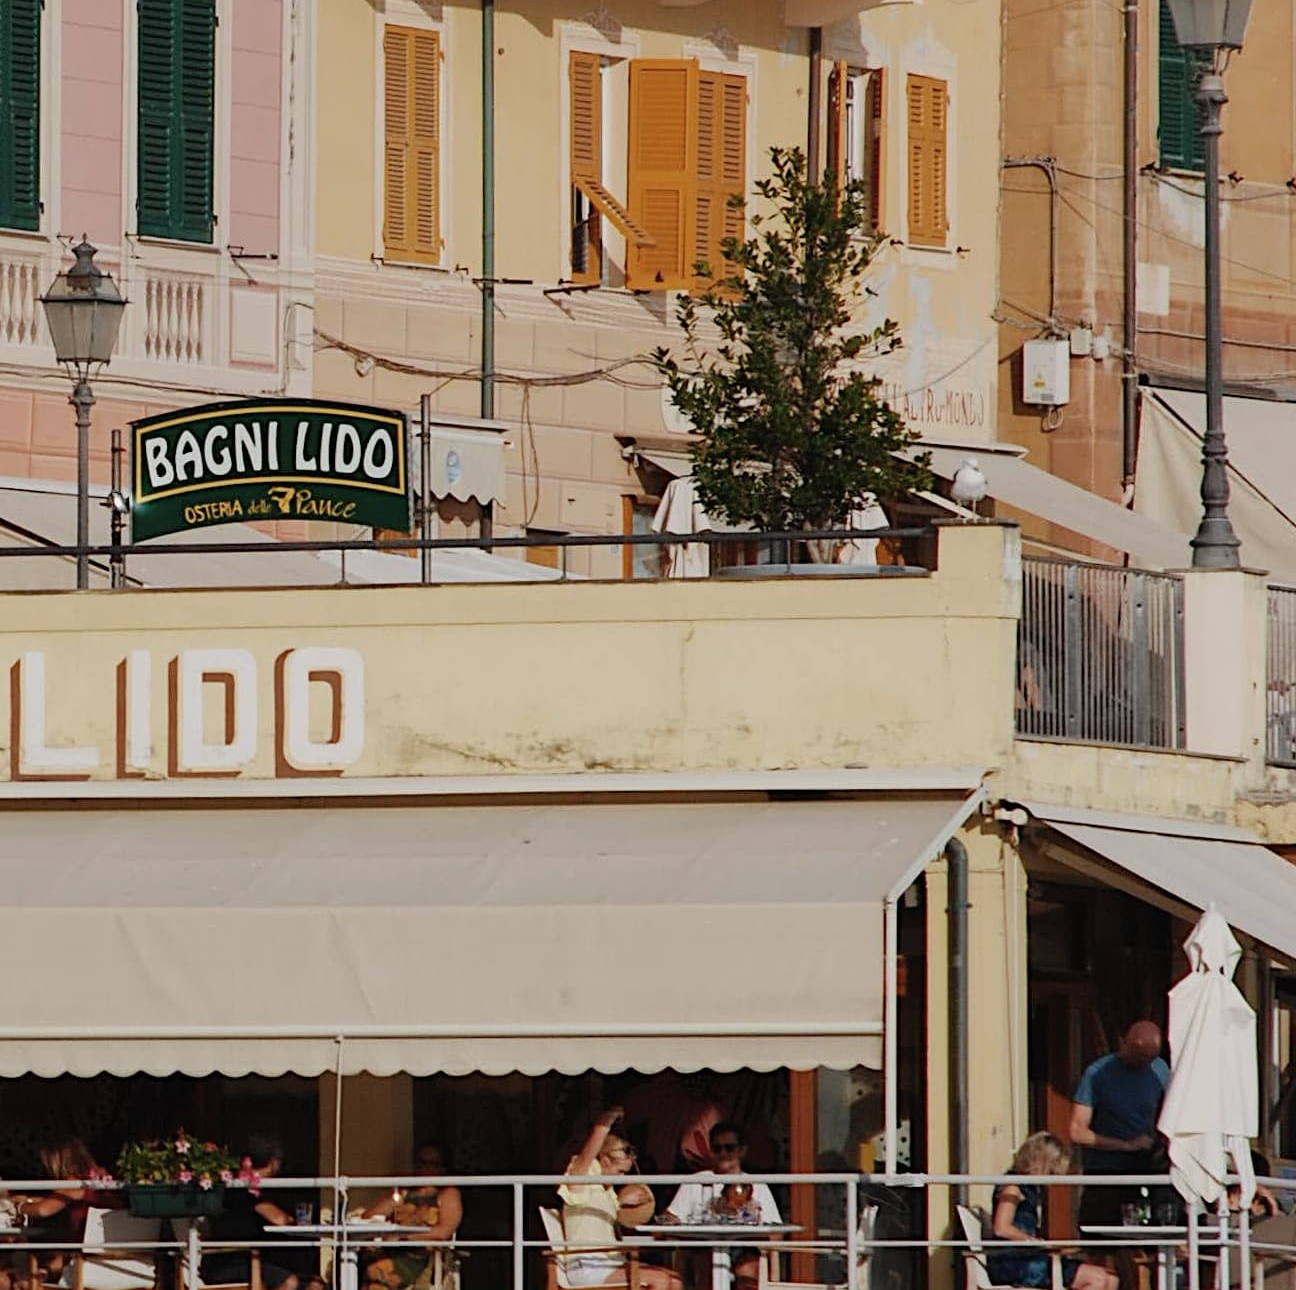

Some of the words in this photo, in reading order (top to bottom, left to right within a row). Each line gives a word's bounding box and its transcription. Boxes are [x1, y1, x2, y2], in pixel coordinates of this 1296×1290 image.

[145, 420, 279, 488] BAGNI
[295, 420, 395, 480] LIDO
[184, 499, 244, 524] OSTERIA
[11, 646, 366, 779] LIDO
